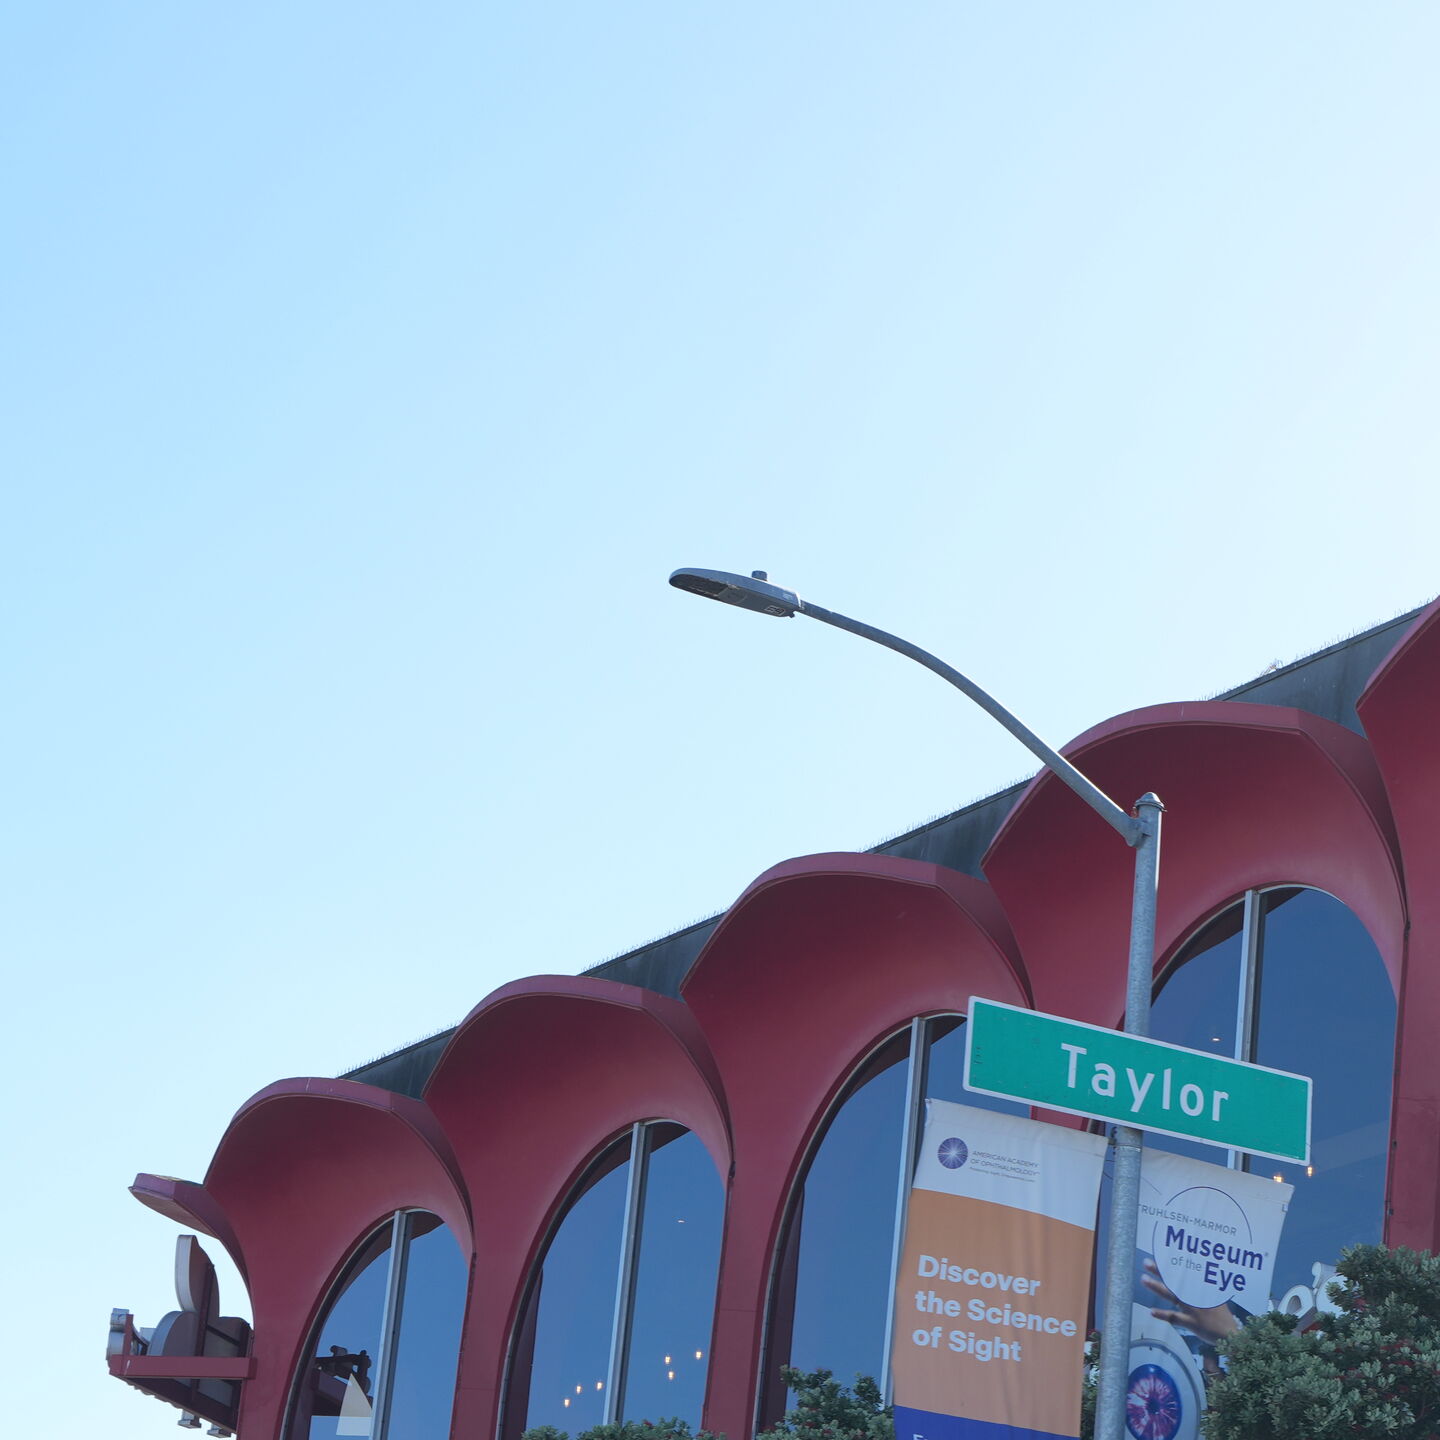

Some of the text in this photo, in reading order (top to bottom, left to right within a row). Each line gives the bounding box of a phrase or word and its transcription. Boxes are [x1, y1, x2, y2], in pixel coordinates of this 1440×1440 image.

[1061, 1043, 1229, 1122] Taylor
[1165, 1225, 1263, 1270] Museum
[1171, 1257, 1202, 1271] of the
[918, 1255, 1040, 1296] Discover
[1204, 1261, 1246, 1291] Eye
[915, 1291, 1077, 1337] the Science
[913, 1326, 1021, 1362] of Sight
